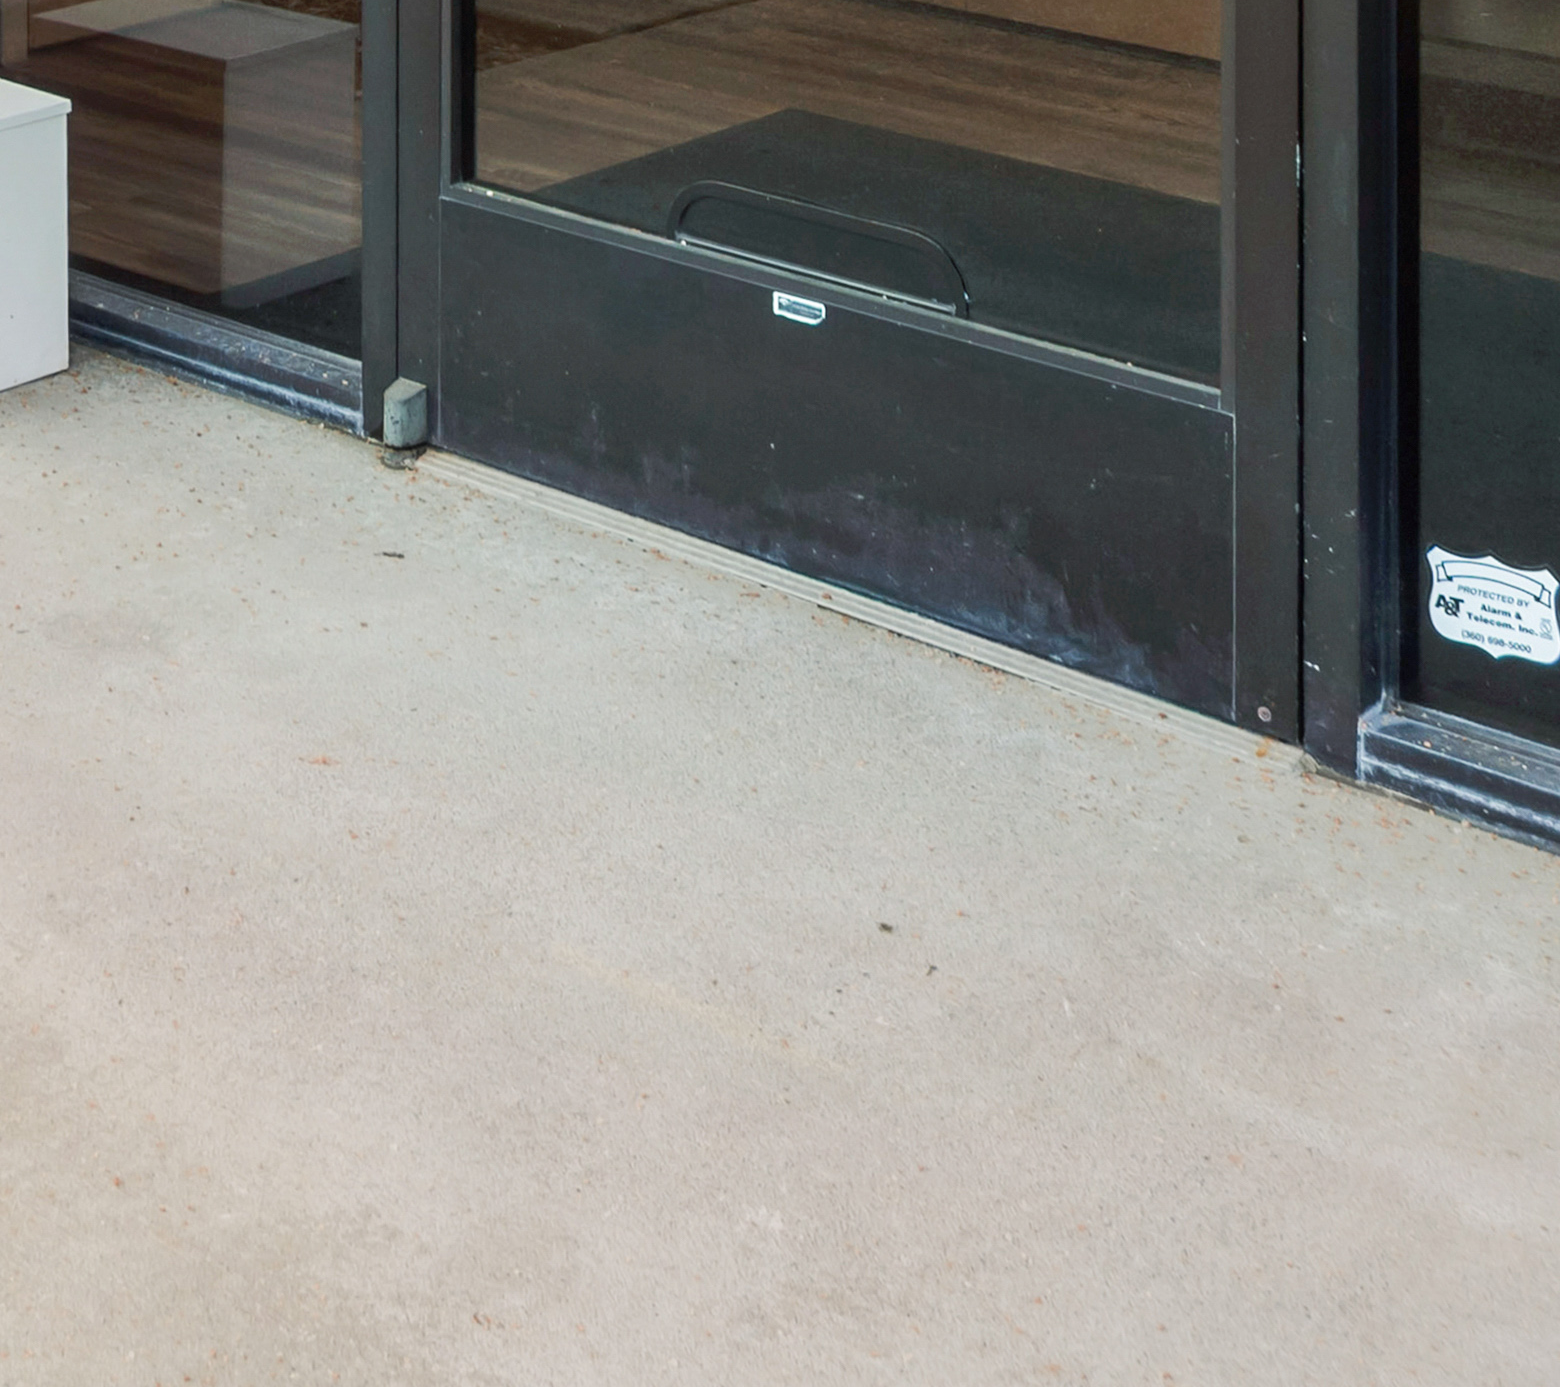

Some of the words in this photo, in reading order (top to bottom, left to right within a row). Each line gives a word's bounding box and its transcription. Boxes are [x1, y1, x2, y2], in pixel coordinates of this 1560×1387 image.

[1457, 585, 1515, 604] PROTECTED
[1516, 597, 1530, 607] BY
[1480, 604, 1512, 618] Alarm
[1514, 612, 1523, 621] &
[1461, 629, 1485, 644] (360)
[1518, 625, 1539, 637] Inc.
